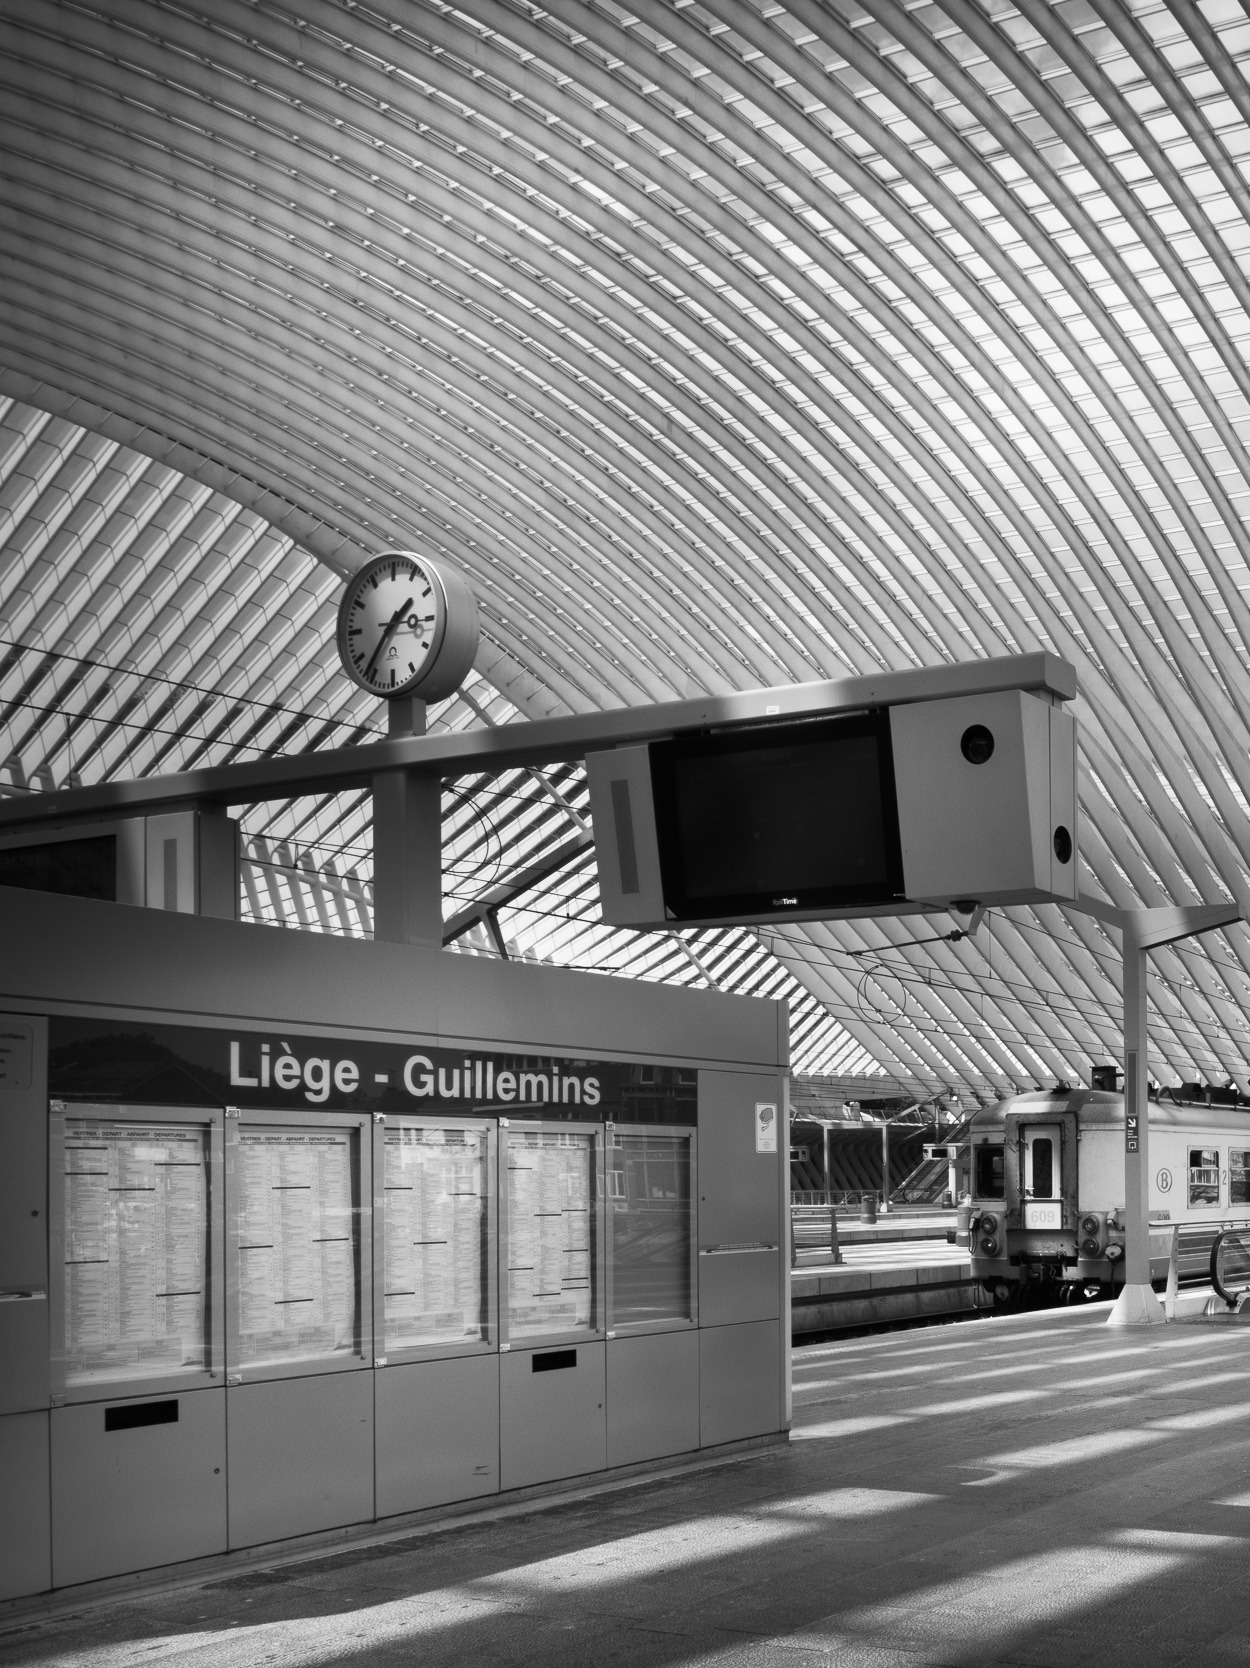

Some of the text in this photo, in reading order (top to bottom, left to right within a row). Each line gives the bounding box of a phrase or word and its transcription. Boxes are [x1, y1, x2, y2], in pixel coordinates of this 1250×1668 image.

[230, 1041, 602, 1106] Liège - Guillemins
[1222, 1169, 1228, 1185] 2
[1031, 1210, 1055, 1223] 609
